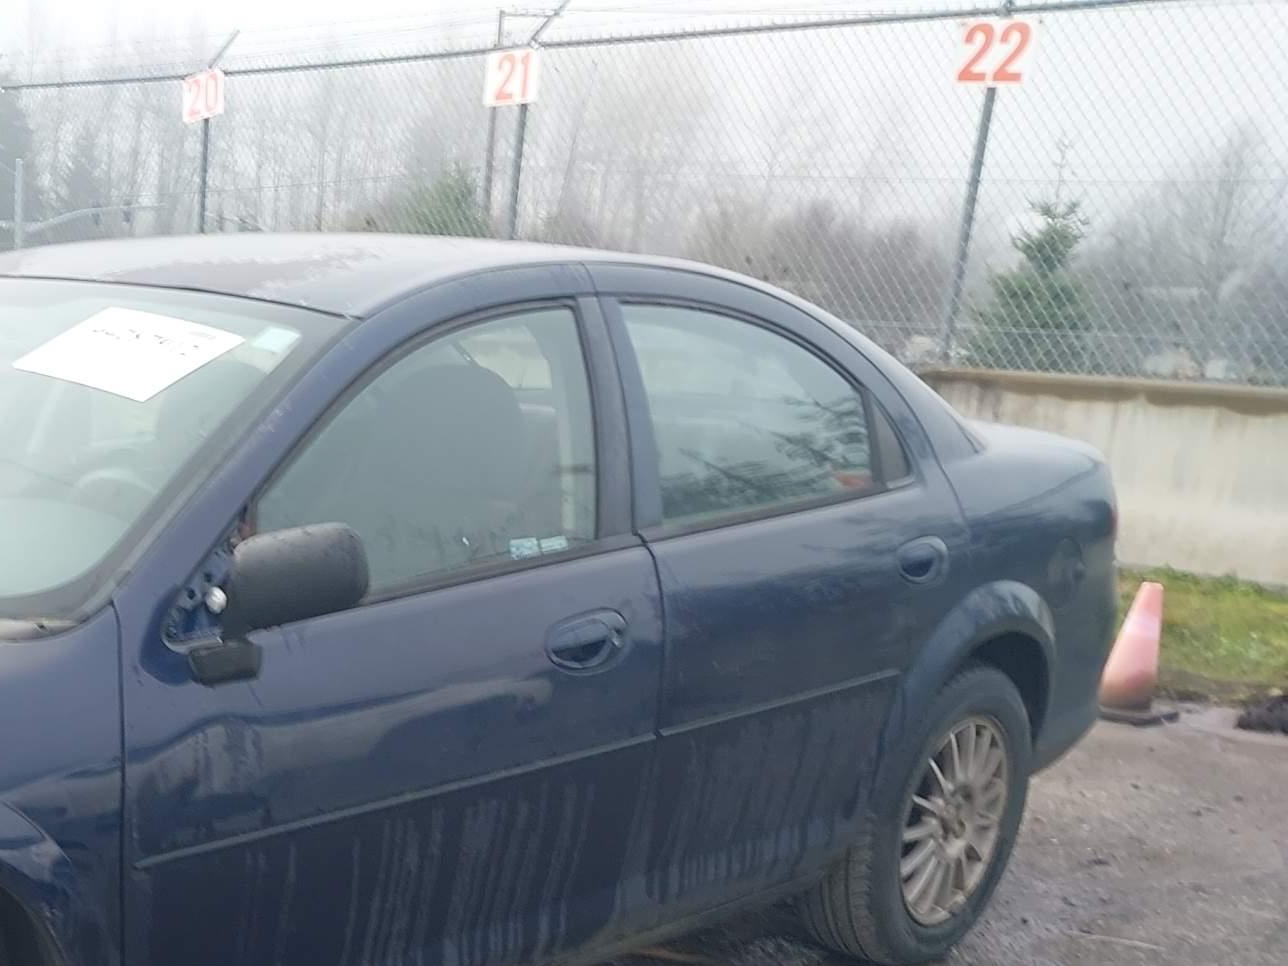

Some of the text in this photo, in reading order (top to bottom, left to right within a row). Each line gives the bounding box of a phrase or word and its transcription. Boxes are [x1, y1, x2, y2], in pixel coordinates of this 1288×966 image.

[957, 21, 1031, 82] 22
[185, 73, 219, 119] 20
[495, 52, 532, 101] 21
